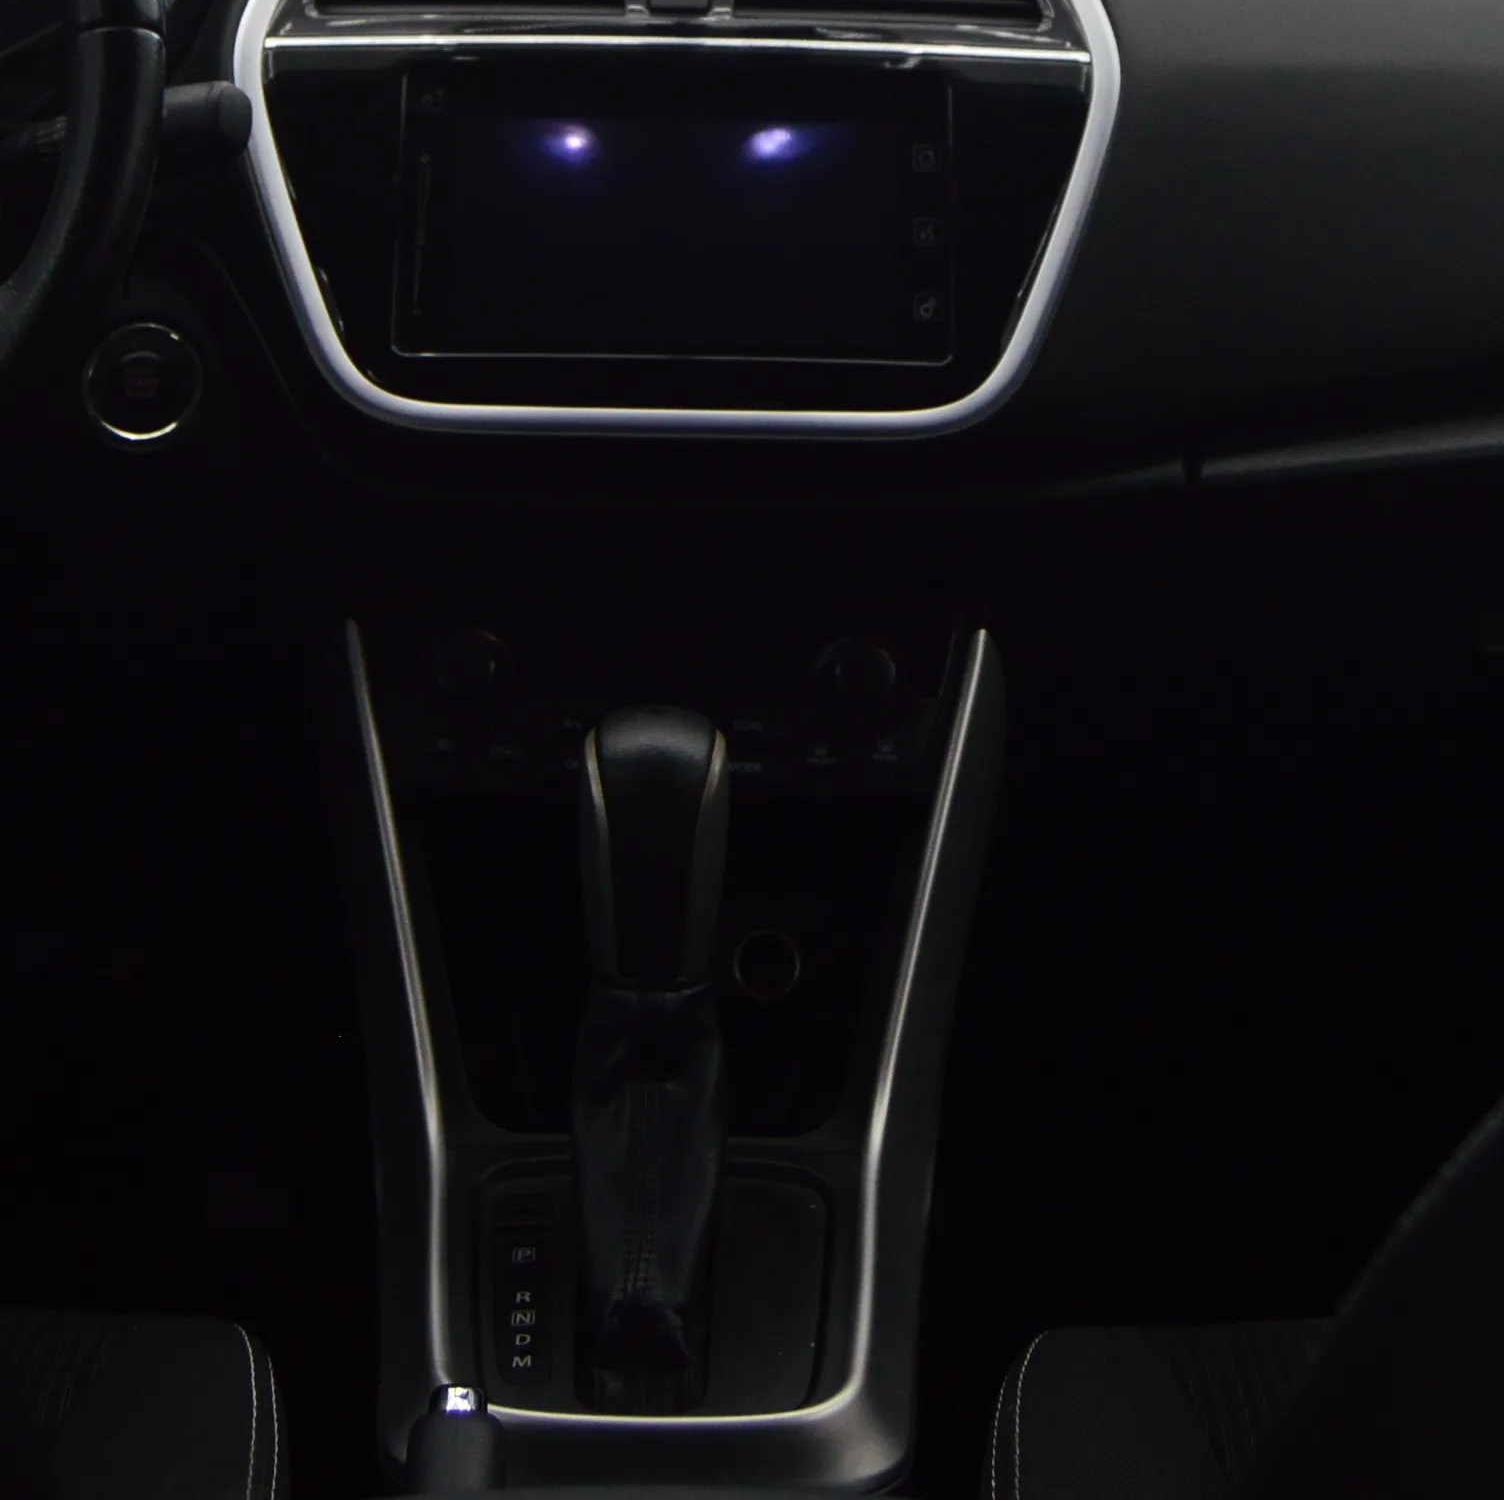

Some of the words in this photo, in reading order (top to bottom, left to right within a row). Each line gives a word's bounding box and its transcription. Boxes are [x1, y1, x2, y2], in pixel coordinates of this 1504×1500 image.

[515, 1290, 533, 1304] R
[515, 1333, 532, 1346] D
[511, 1354, 533, 1368] M
